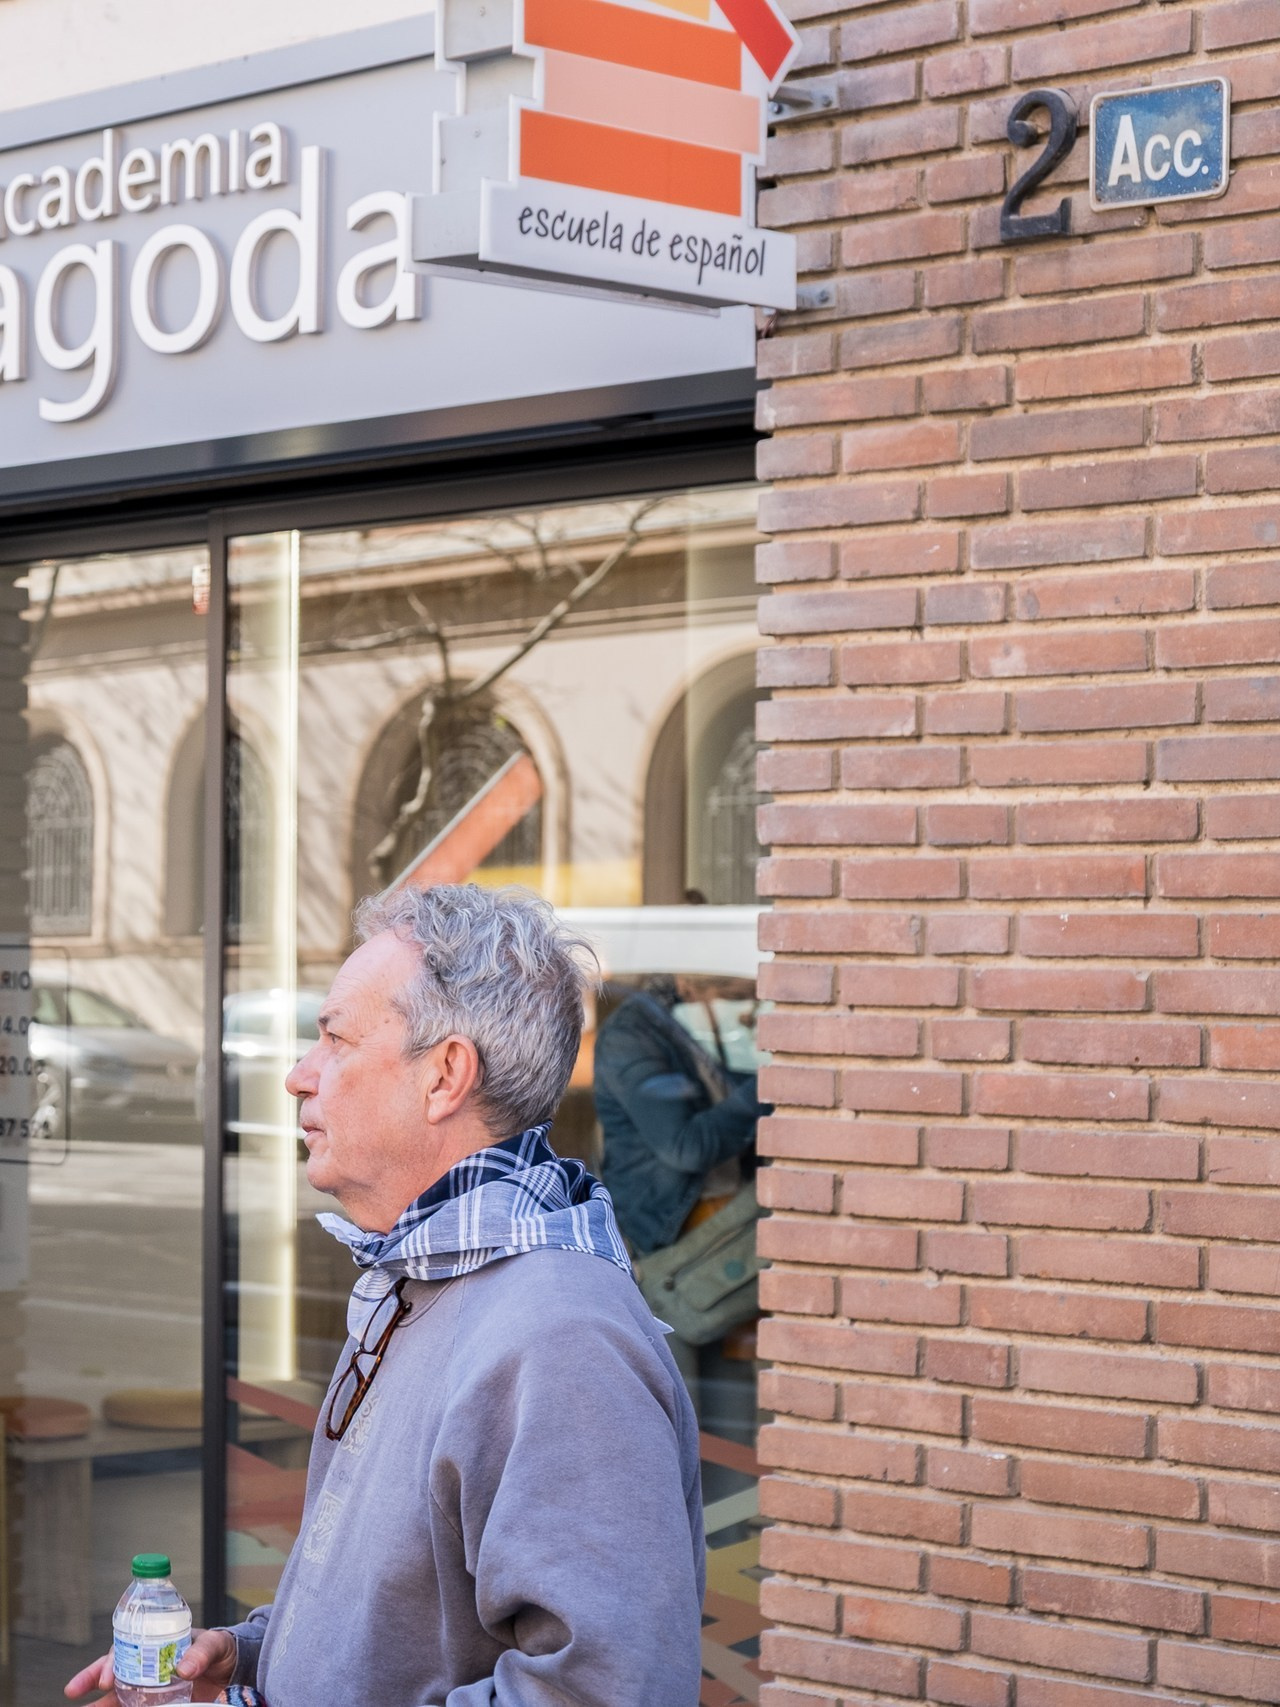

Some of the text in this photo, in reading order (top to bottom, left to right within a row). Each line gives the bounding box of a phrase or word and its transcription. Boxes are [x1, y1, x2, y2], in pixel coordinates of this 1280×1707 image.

[1000, 88, 1077, 242] 2
[1107, 114, 1209, 187] Acc.
[518, 205, 766, 286] escuela de español
